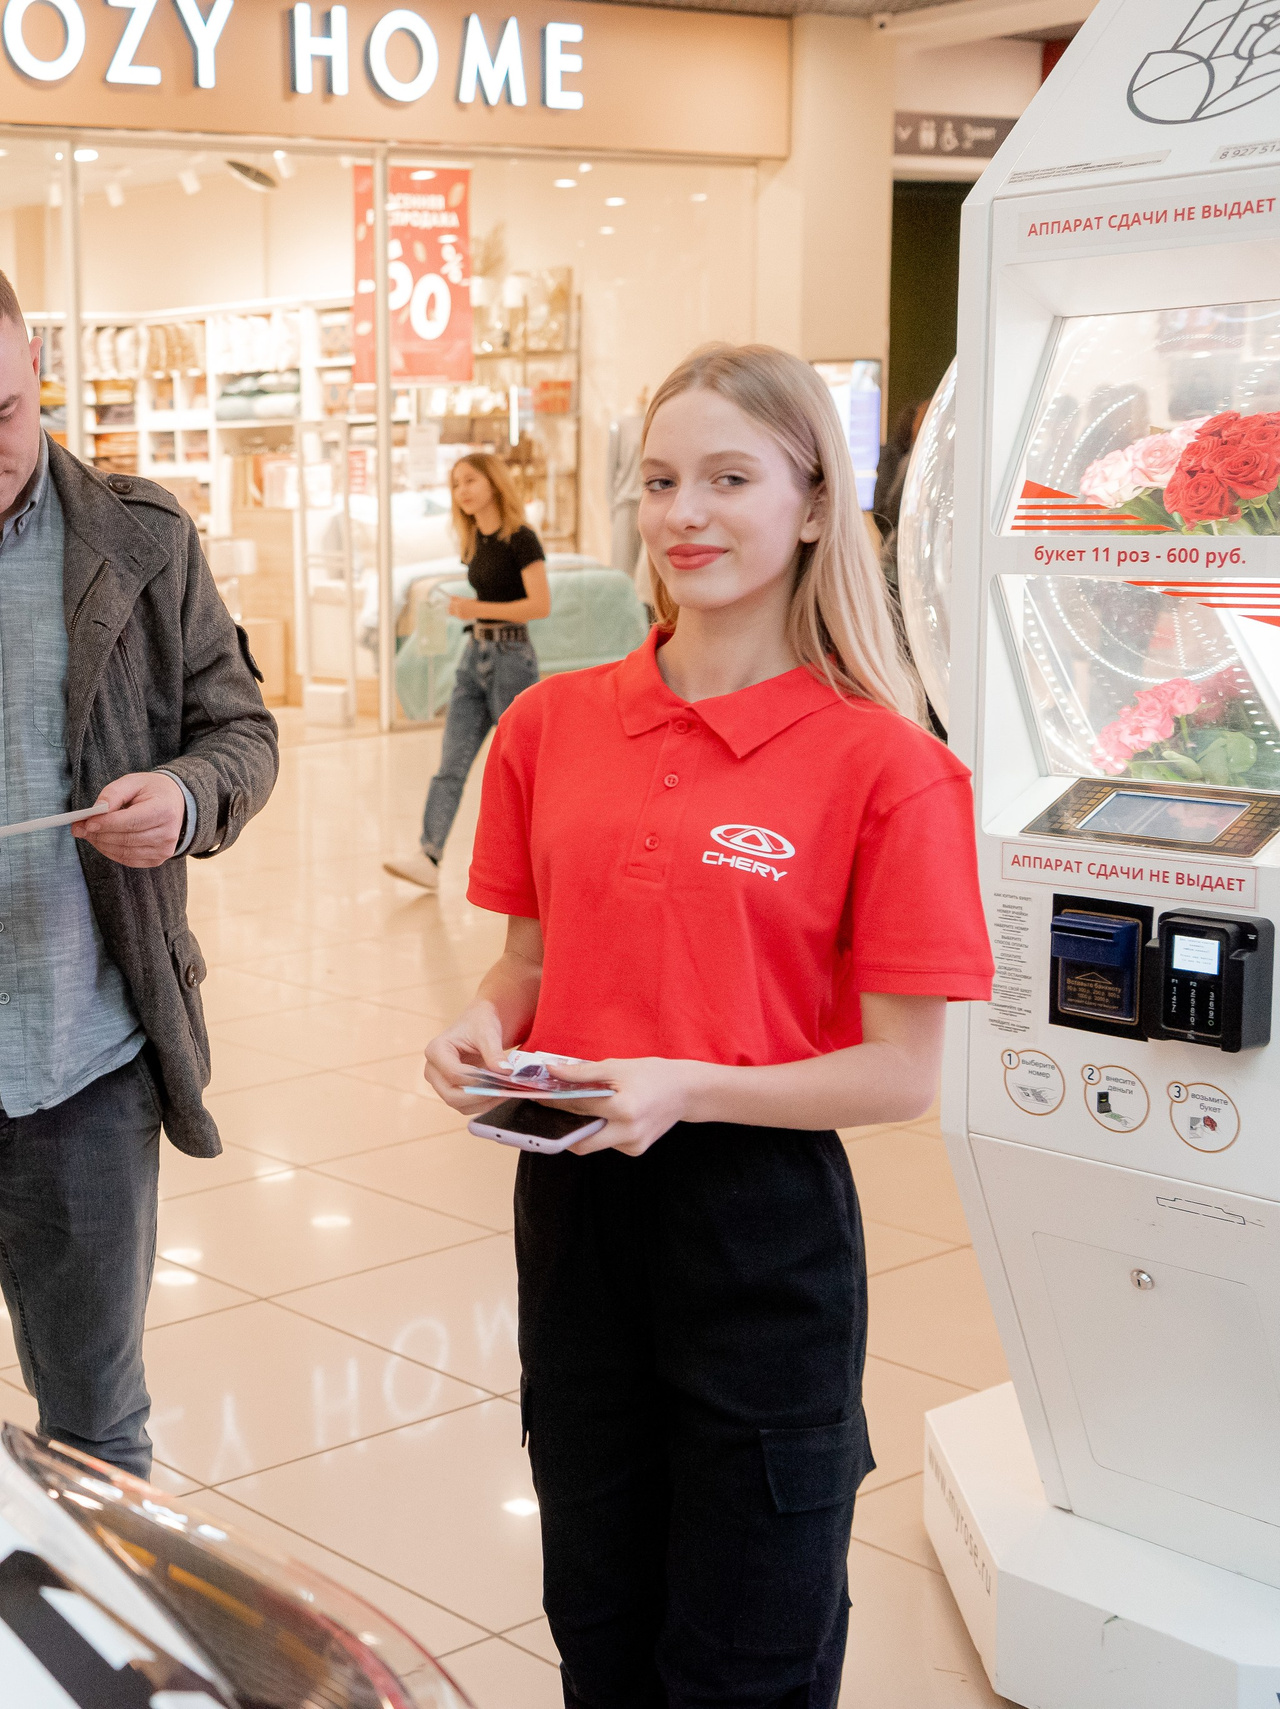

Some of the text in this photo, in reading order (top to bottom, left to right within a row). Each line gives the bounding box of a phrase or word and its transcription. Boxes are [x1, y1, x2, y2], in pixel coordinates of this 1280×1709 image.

[292, 2, 584, 110] HOME
[1027, 197, 1277, 237] АППАРАТ СДАЧИ НЕ ВЫДАЕТ
[1034, 545, 1086, 566] букет
[1092, 546, 1110, 563] 11
[1117, 549, 1150, 567] роз
[1166, 547, 1200, 564] 600
[1205, 547, 1246, 569] руб.
[701, 850, 788, 882] CHERY
[1011, 853, 1246, 892] АППАРАТ СДАЧИ НЕ ВЫДАЕТ
[1007, 1053, 1012, 1065] 1
[1021, 1058, 1056, 1070] выберите
[1028, 1069, 1051, 1079] номер
[1087, 1067, 1095, 1081] 2
[1105, 1075, 1136, 1086] внесите
[1107, 1084, 1133, 1095] деньги
[1174, 1085, 1181, 1098] 3
[1191, 1092, 1228, 1105] возьмите
[1199, 1102, 1222, 1113] букет
